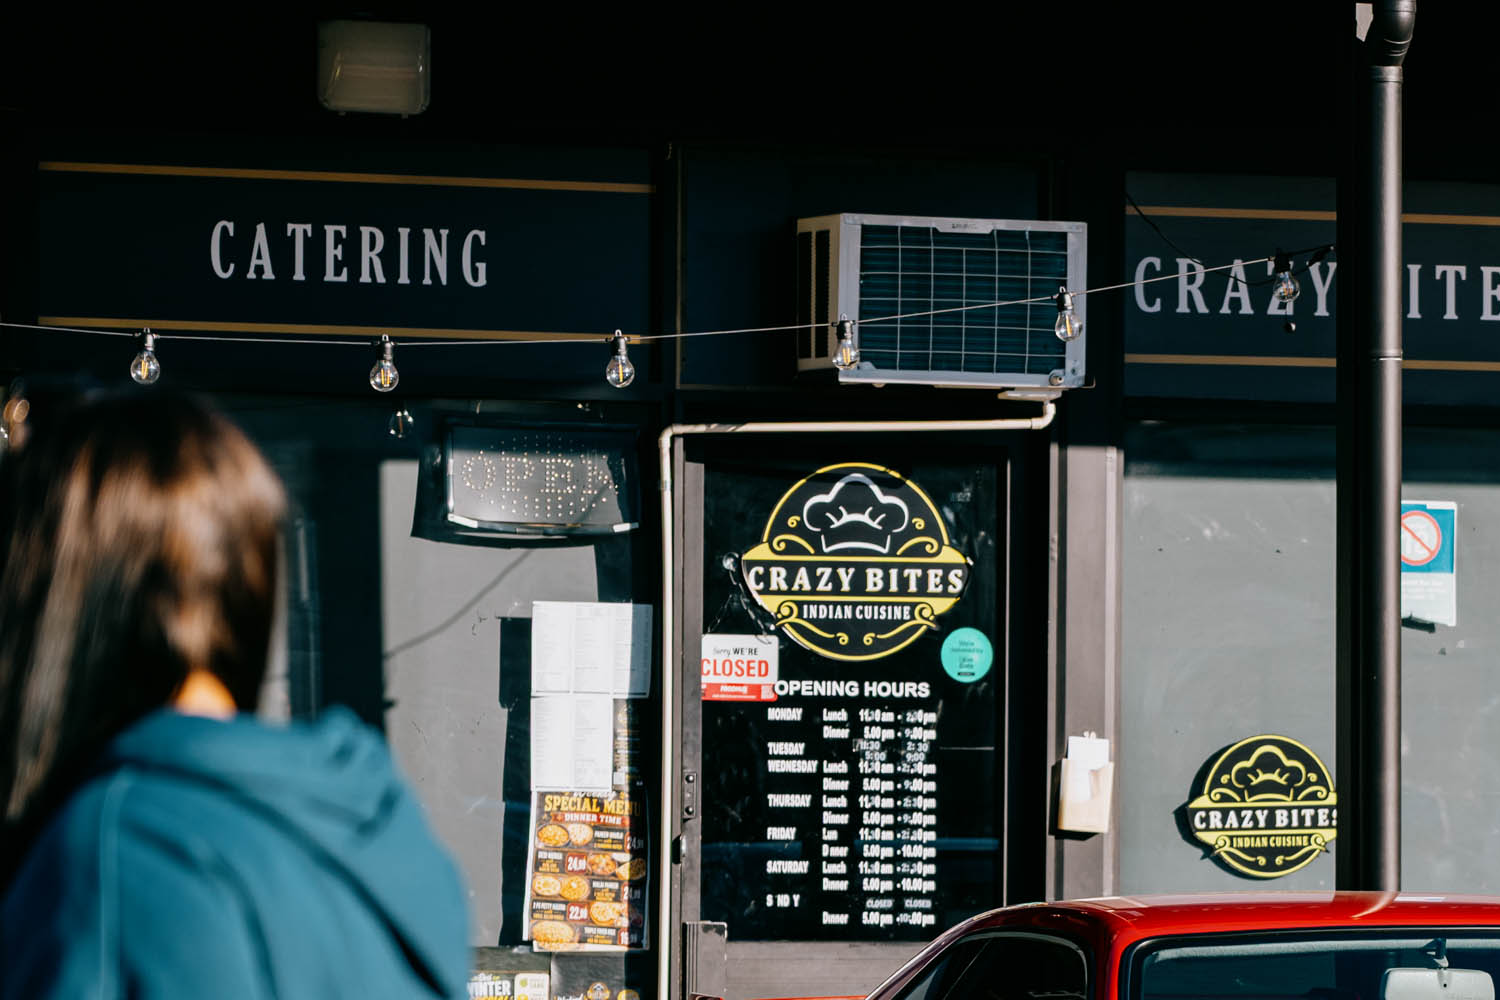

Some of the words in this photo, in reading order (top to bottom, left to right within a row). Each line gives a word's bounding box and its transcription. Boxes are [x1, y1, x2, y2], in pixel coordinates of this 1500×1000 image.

[210, 220, 487, 288] CATERING
[463, 454, 618, 495] OPEN
[749, 566, 855, 592] CRAZY
[865, 567, 964, 593] BITES
[802, 604, 852, 620] INDIAN
[855, 604, 911, 621] CUISINE
[732, 647, 759, 656] WE'RE
[701, 658, 769, 678] CLOSED
[774, 680, 860, 697] OPENING
[863, 681, 931, 698] HOURS
[767, 707, 803, 721] MONDAY
[823, 708, 848, 722] Lunch
[823, 725, 850, 739] Dinner
[767, 741, 806, 756] TUESDAY
[767, 759, 819, 774] WEDNESDAY
[823, 760, 848, 774] Lunch
[823, 777, 850, 791] Dinner
[544, 795, 600, 813] SPECIAL
[767, 793, 812, 808] THURSDAY
[823, 795, 848, 808] Lunch
[823, 811, 850, 825] Dinner
[1193, 809, 1269, 829] CRAZY
[766, 827, 797, 841] FRIDAY
[1232, 836, 1268, 848] INDIAN
[1269, 835, 1309, 847] CUISINE
[766, 860, 810, 874] SATURDAY
[822, 861, 847, 875] Lunch
[822, 877, 849, 891] Dinner
[822, 911, 849, 925] Dinner
